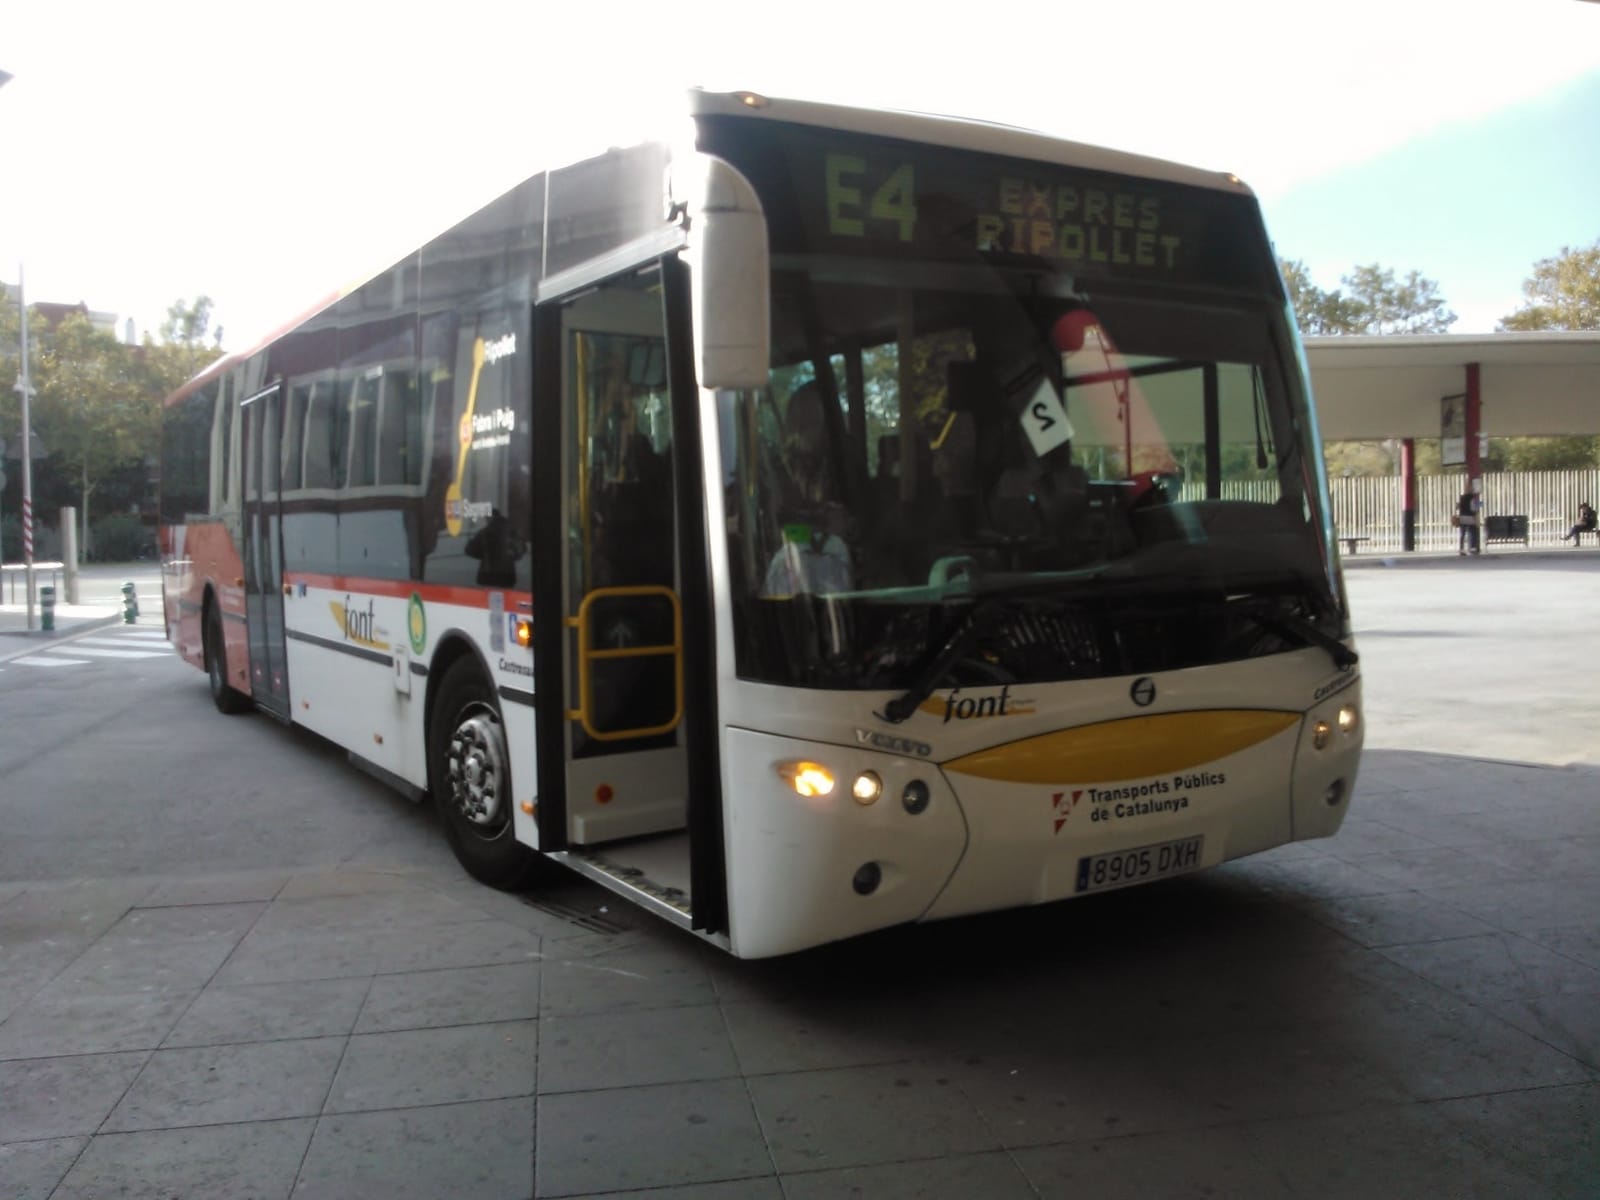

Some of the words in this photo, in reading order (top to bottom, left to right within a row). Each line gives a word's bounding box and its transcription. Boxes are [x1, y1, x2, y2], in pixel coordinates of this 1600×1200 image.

[825, 154, 917, 242] E4
[1000, 176, 1159, 228] EXPRES
[976, 214, 1181, 269] RIPOLLET
[496, 407, 514, 431] Puig
[343, 595, 375, 643] font
[942, 685, 1011, 724] font
[1088, 781, 1170, 803] Transports
[1174, 772, 1226, 791] Públics
[1091, 808, 1109, 822] de
[1115, 796, 1189, 818] Catalunya
[1094, 851, 1150, 884] 8905
[1158, 840, 1199, 872] DXH
